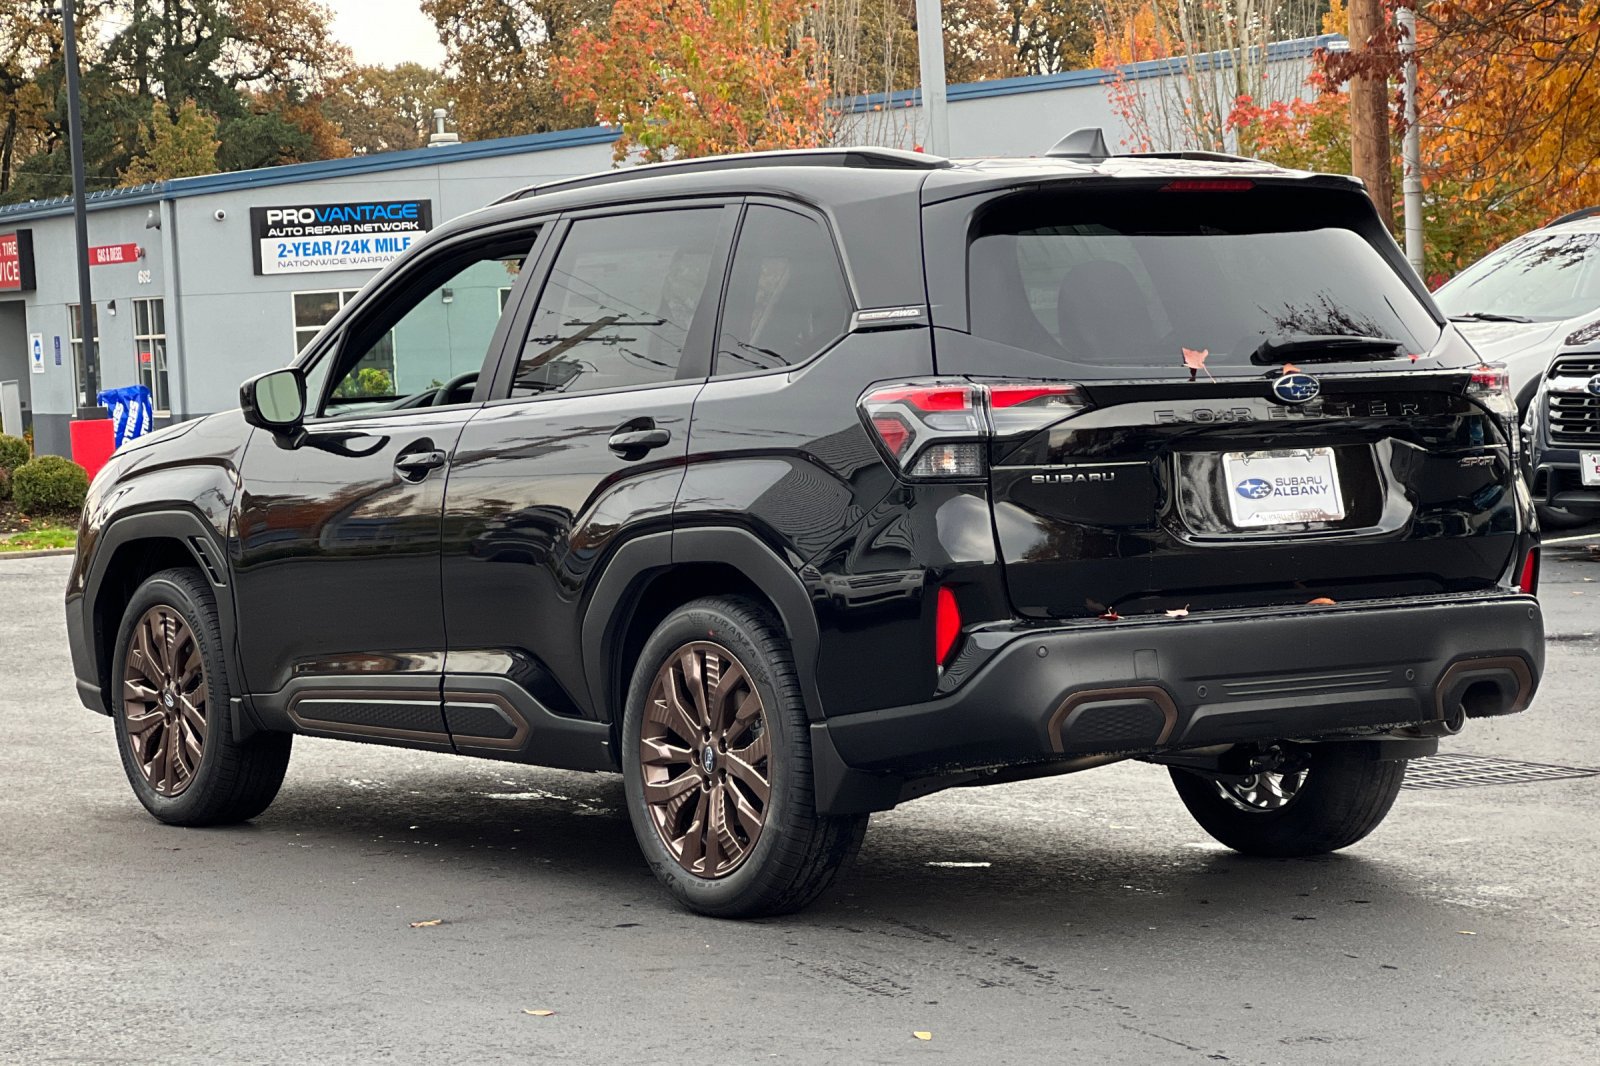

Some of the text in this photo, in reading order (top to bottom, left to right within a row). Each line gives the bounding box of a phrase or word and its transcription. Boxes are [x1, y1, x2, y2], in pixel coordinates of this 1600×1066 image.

[267, 203, 418, 225] PROVANTAGE
[268, 221, 419, 237] AUTO REPAIR NETWORK
[2, 241, 17, 256] TIRE
[97, 248, 106, 262] GAS
[110, 246, 123, 261] DIESEL
[278, 255, 397, 268] NATIONWIDE WARRAN
[888, 309, 919, 318] AWD
[124, 400, 139, 438] TIRES
[1153, 402, 1420, 424] FORESTER
[1460, 455, 1496, 467] SPORT
[1031, 472, 1115, 484] SUBARU
[1275, 476, 1322, 487] SUBARU
[1273, 484, 1328, 497] ALBANY
[708, 613, 757, 659] TURANZA
